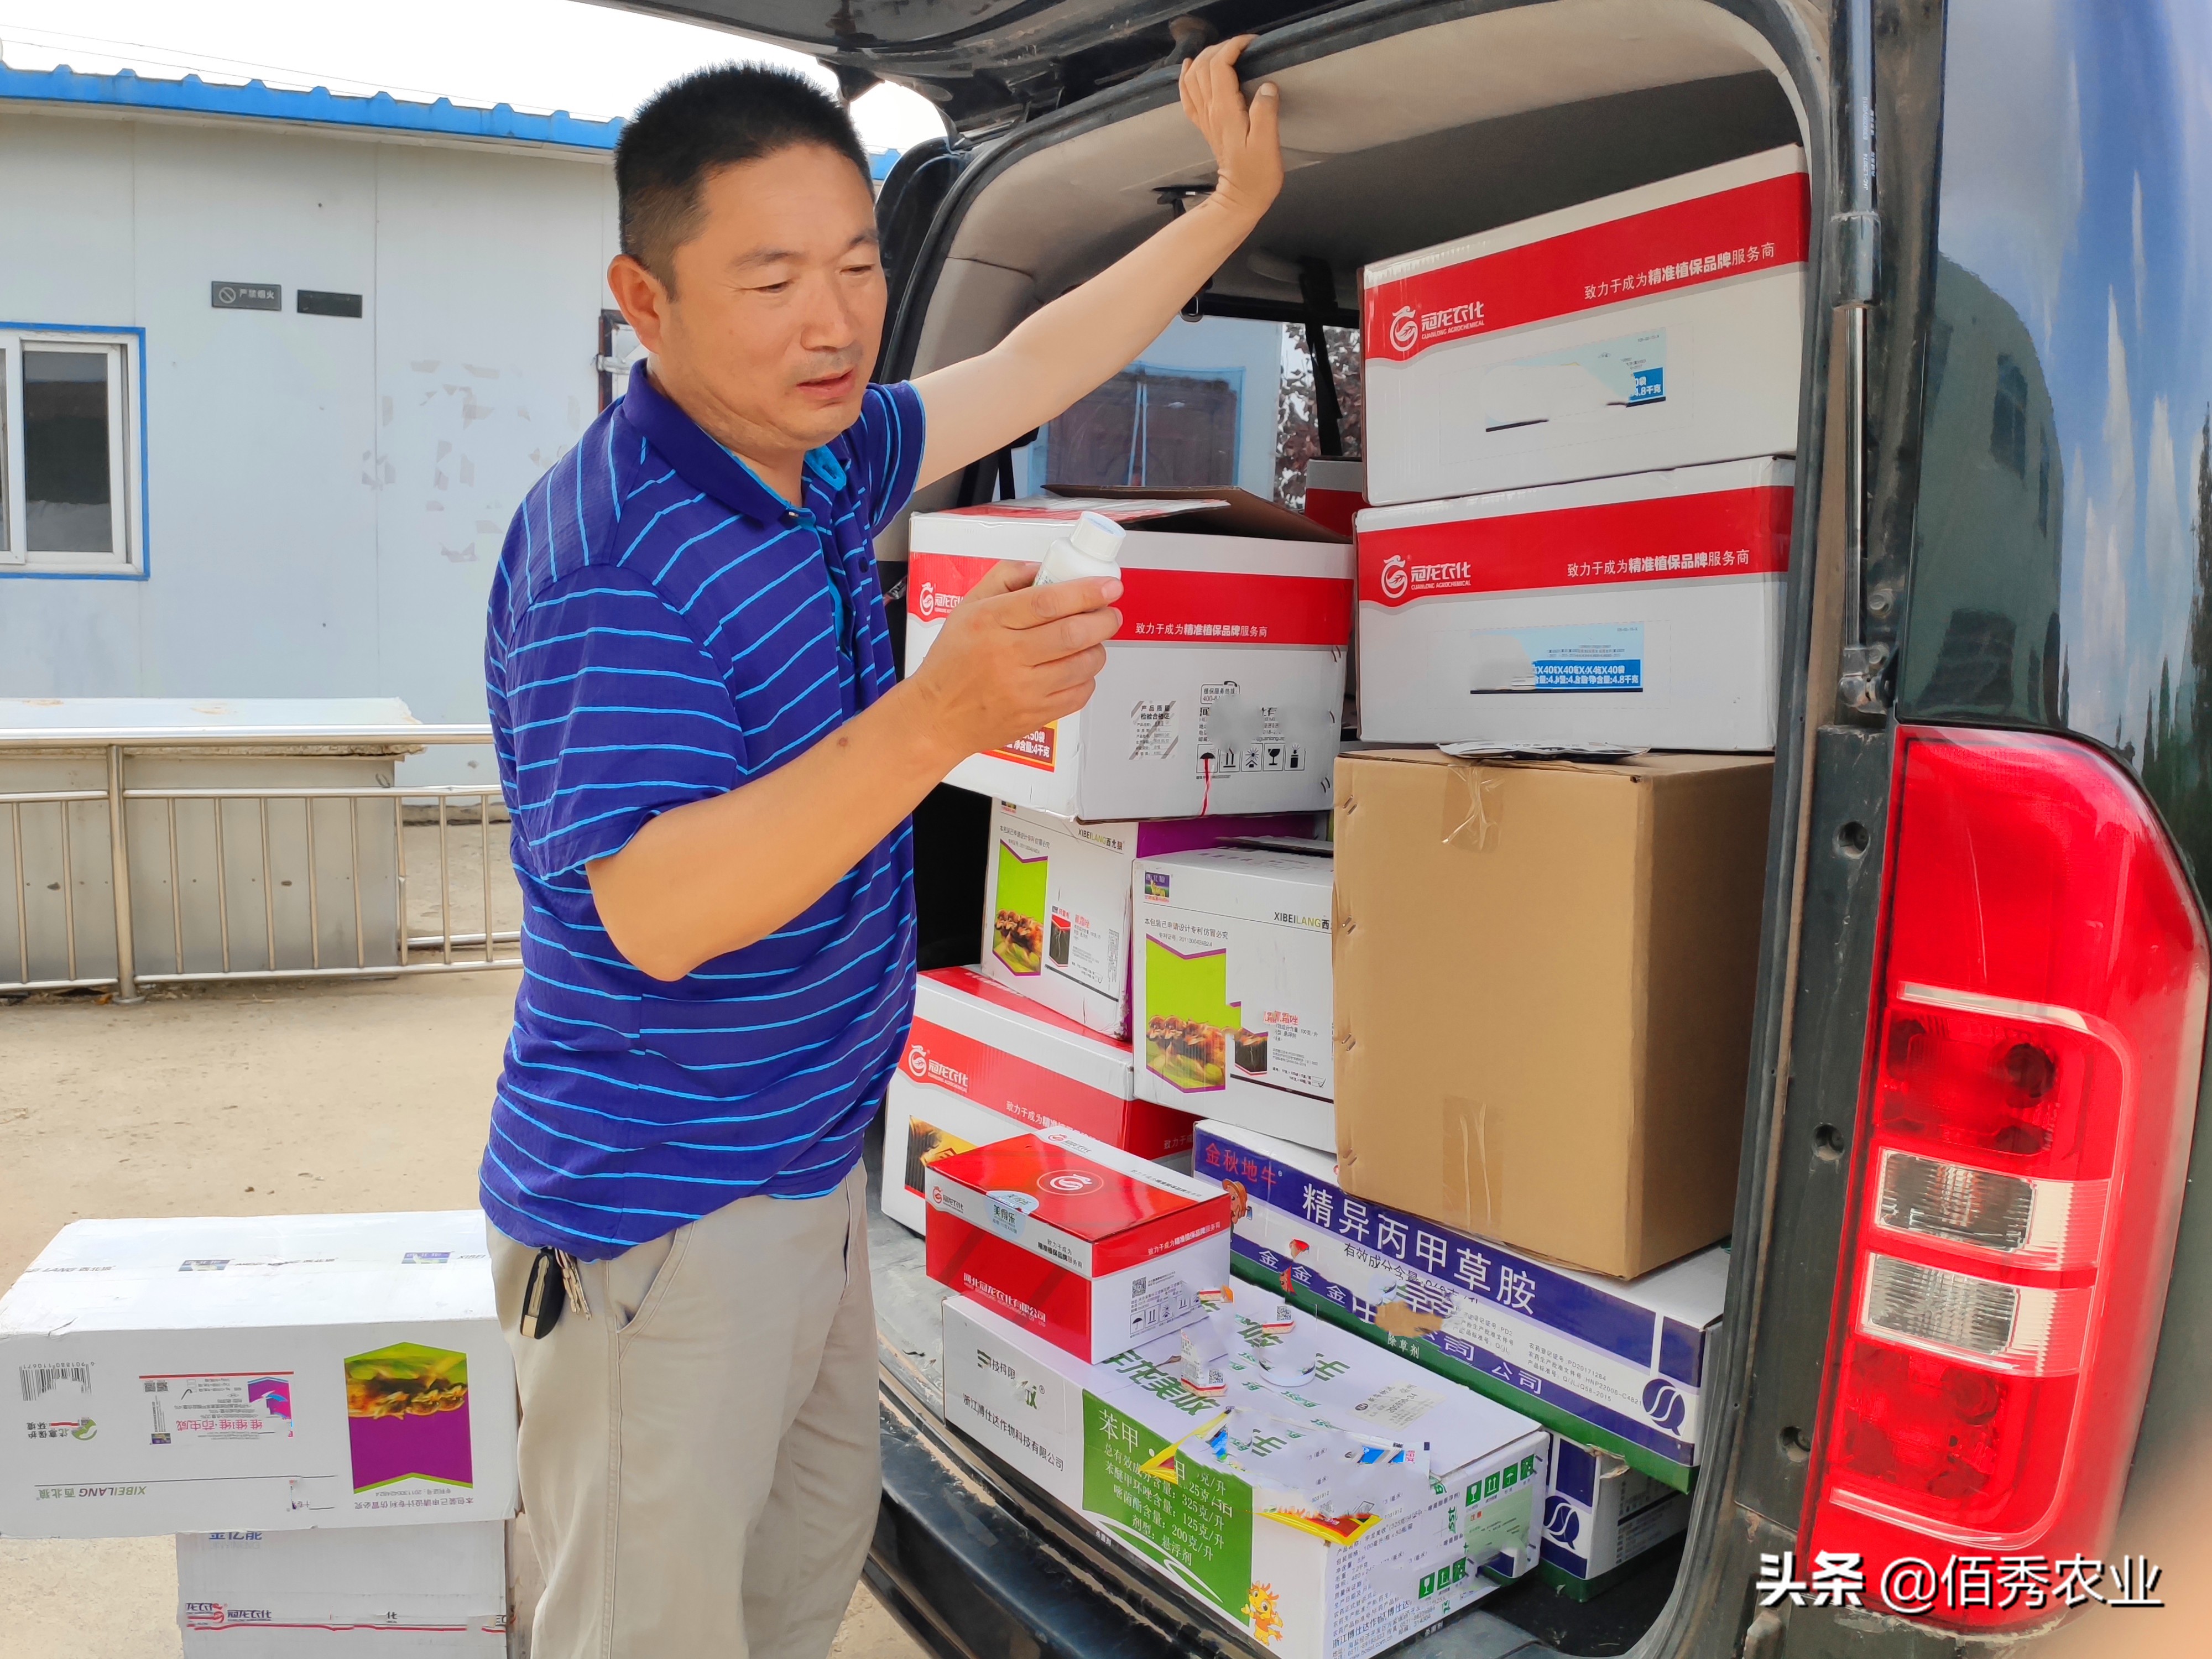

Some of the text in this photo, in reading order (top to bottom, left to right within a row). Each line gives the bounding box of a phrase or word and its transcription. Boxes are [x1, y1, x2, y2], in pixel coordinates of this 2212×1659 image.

[1584, 242, 1775, 300] 致力于成为精准植保品牌服务商
[1421, 301, 1484, 332] 冠龙农化
[1411, 561, 1471, 583] 冠龙农化
[1567, 549, 1750, 578] 致力于成为精准植保品牌服务商
[935, 593, 964, 608] 冠龙农
[1135, 622, 1268, 638] 致力于成为精准植保品牌服务商
[1145, 918, 1229, 940] 本包装已申请设计专利仿冒必究
[928, 1058, 968, 1087] 冠龙农化
[1205, 1142, 1277, 1186] 金秋地牛
[994, 1204, 1016, 1224] 美得乐
[1047, 1238, 1072, 1255] 致力于成为
[1148, 1221, 1220, 1255] 致力于成为精准植保品牌服务商
[1302, 1182, 1536, 1316] 精异丙甲草胺
[1387, 1332, 1420, 1359] 除草剂
[963, 1392, 1063, 1472] 浙江博仕达作物科技有限公司
[79, 1486, 147, 1497] XIBEILANG
[354, 1497, 474, 1510] 本包装已申请设计专利仿冒必究
[227, 1609, 272, 1619] 冠龙农化
